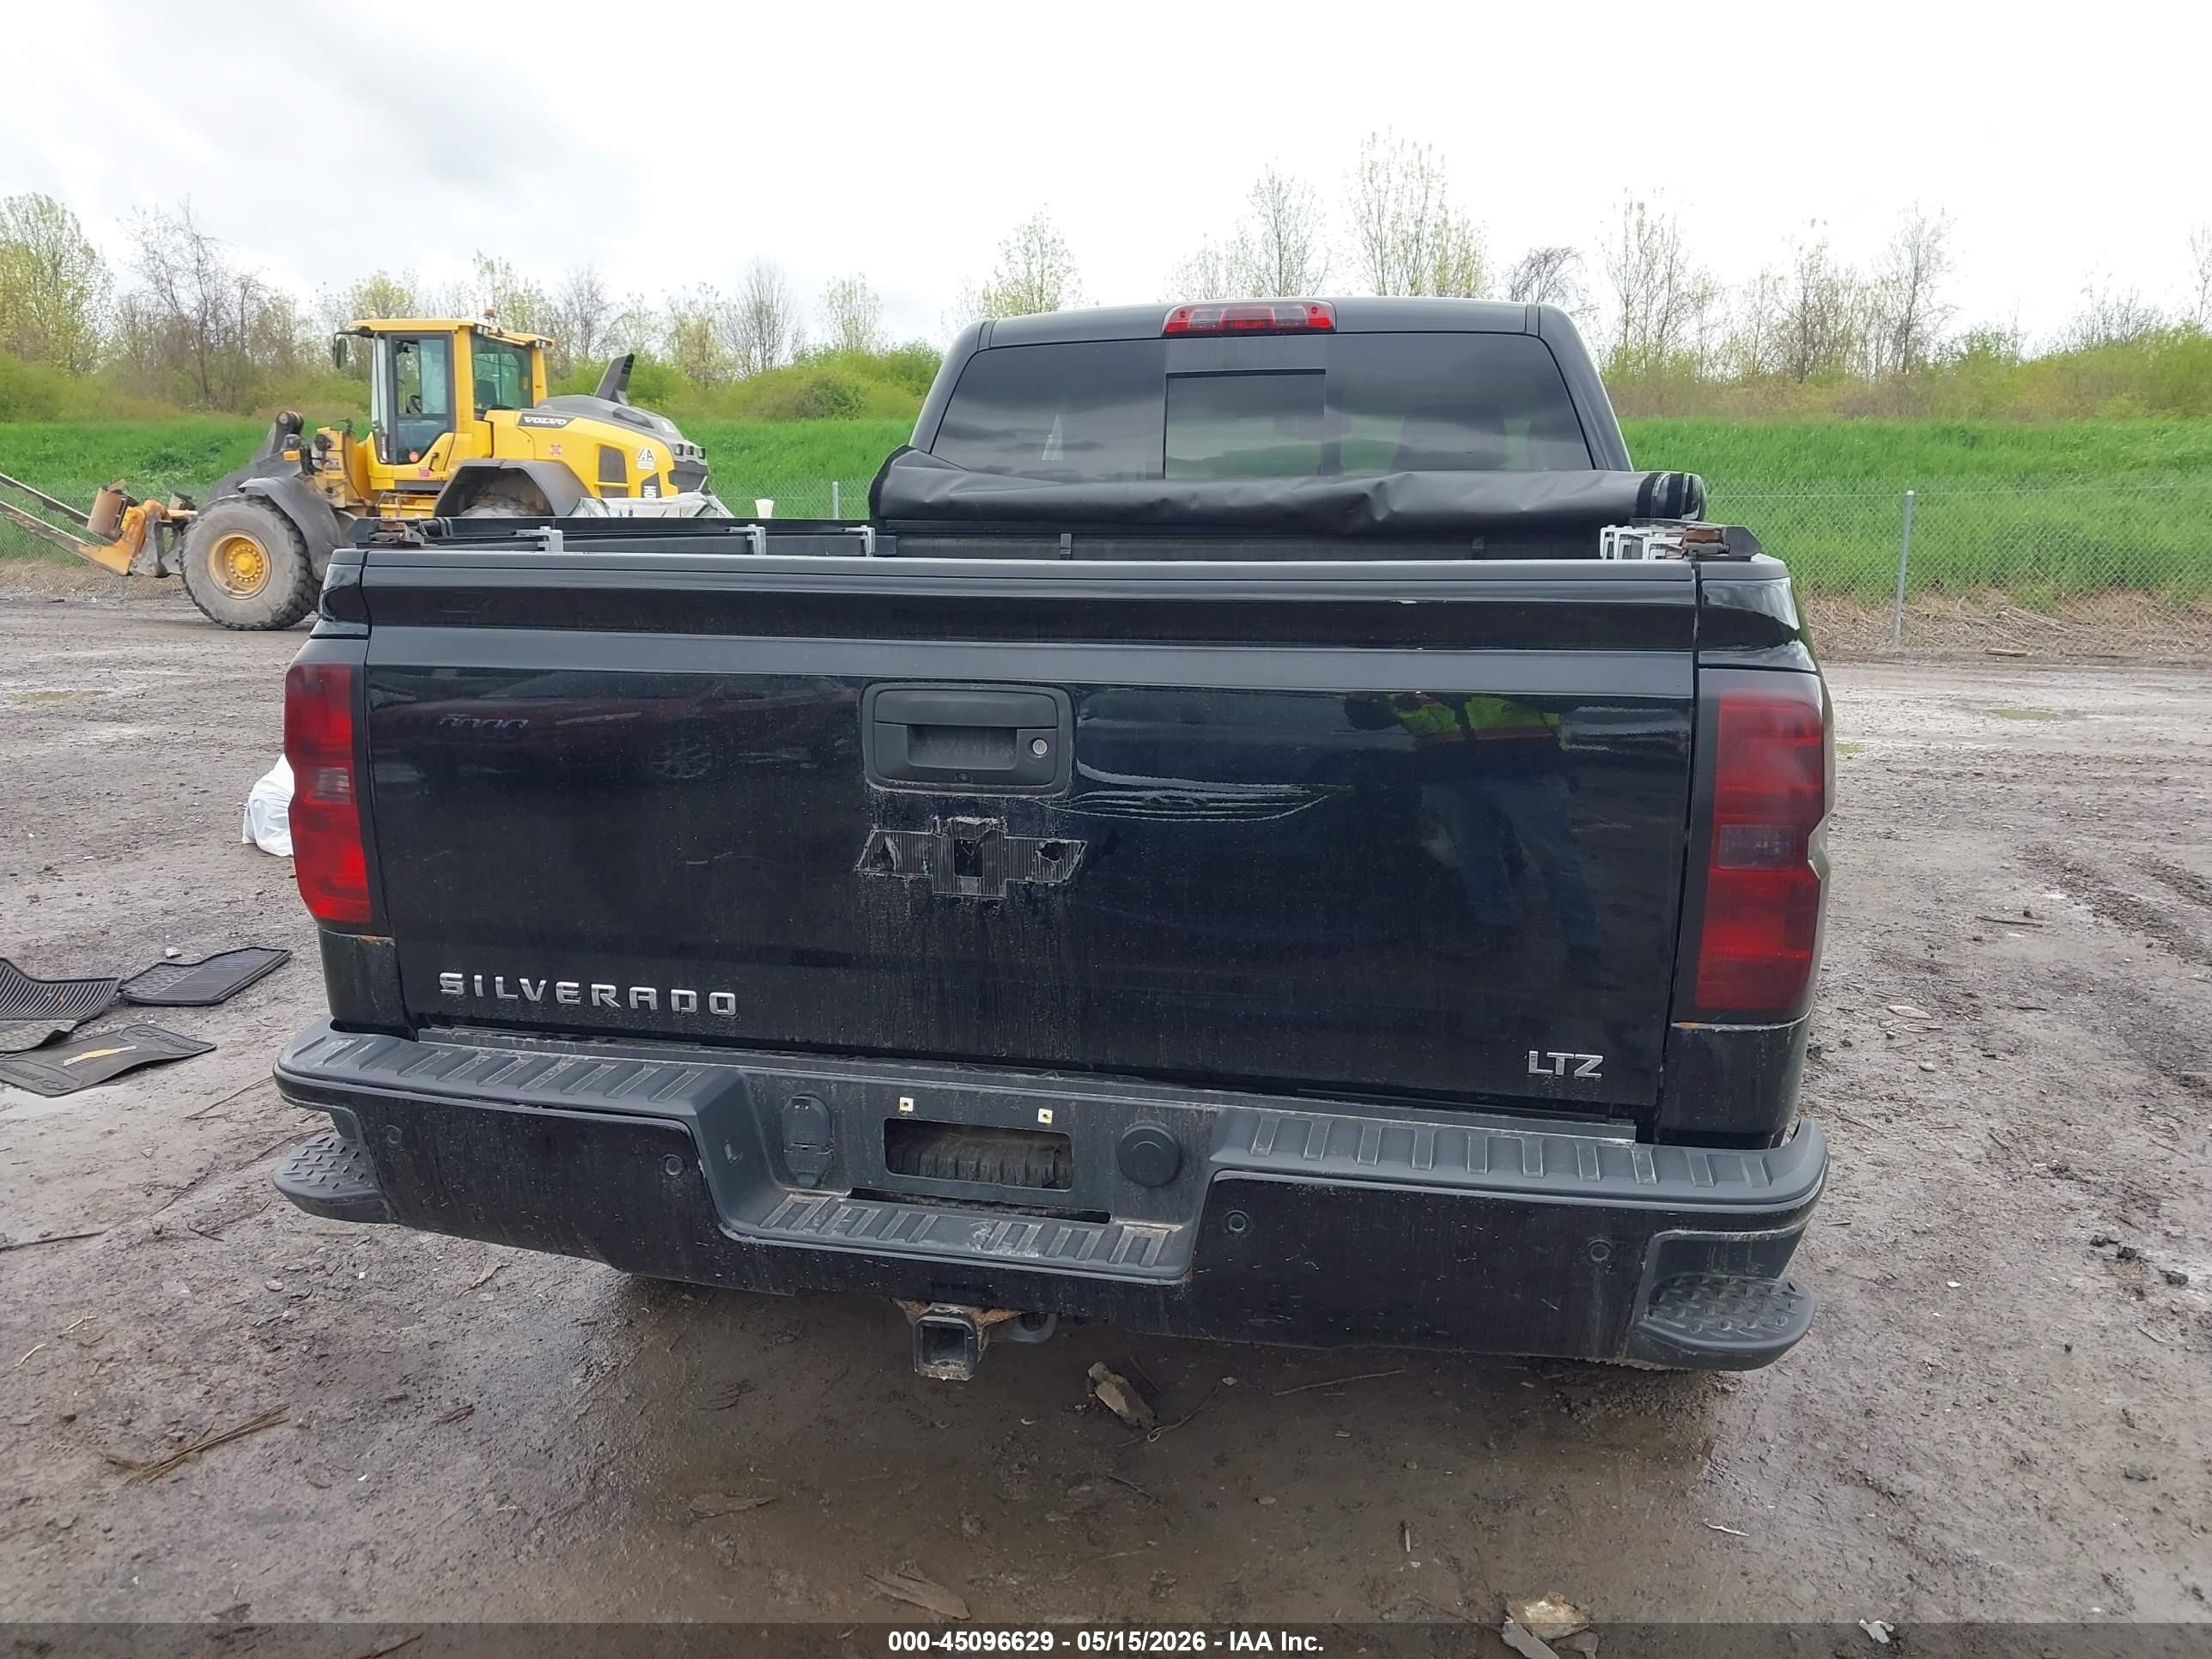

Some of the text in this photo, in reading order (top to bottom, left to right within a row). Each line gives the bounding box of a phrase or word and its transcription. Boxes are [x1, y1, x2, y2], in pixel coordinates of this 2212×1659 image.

[523, 416, 568, 426] VOLVO
[439, 972, 737, 1016] SILVERADO
[1528, 1050, 1604, 1079] LTZ
